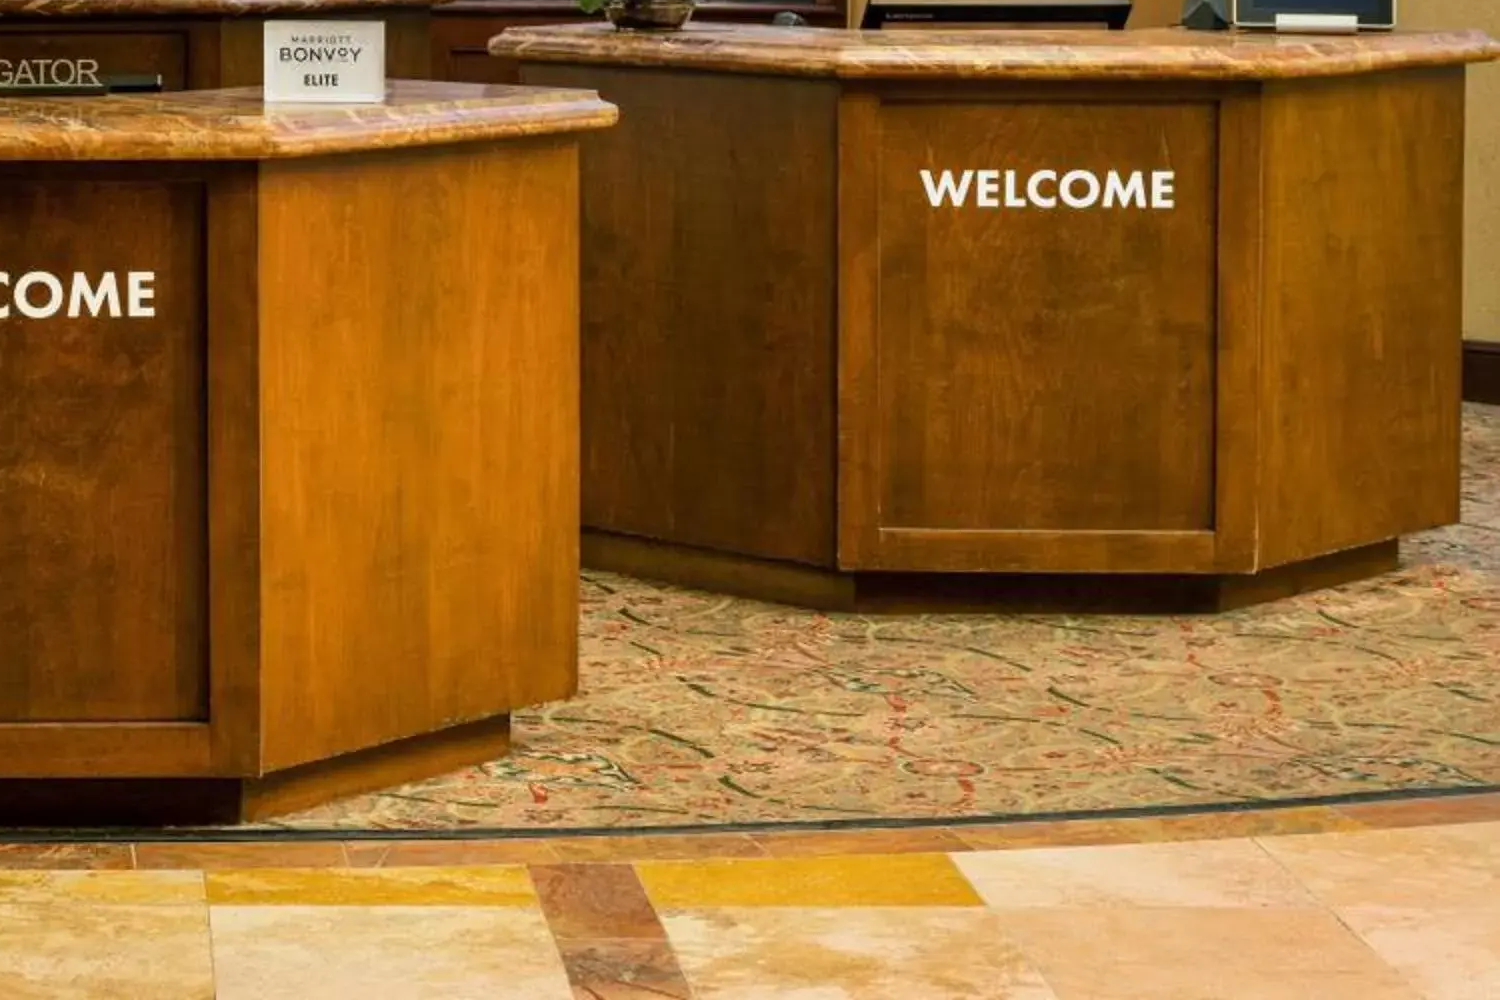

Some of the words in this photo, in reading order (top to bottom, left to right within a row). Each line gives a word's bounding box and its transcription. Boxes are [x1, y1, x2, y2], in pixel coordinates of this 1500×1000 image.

[279, 47, 362, 63] BONVOY
[303, 73, 339, 87] ELITE
[919, 168, 1176, 209] WELCOME
